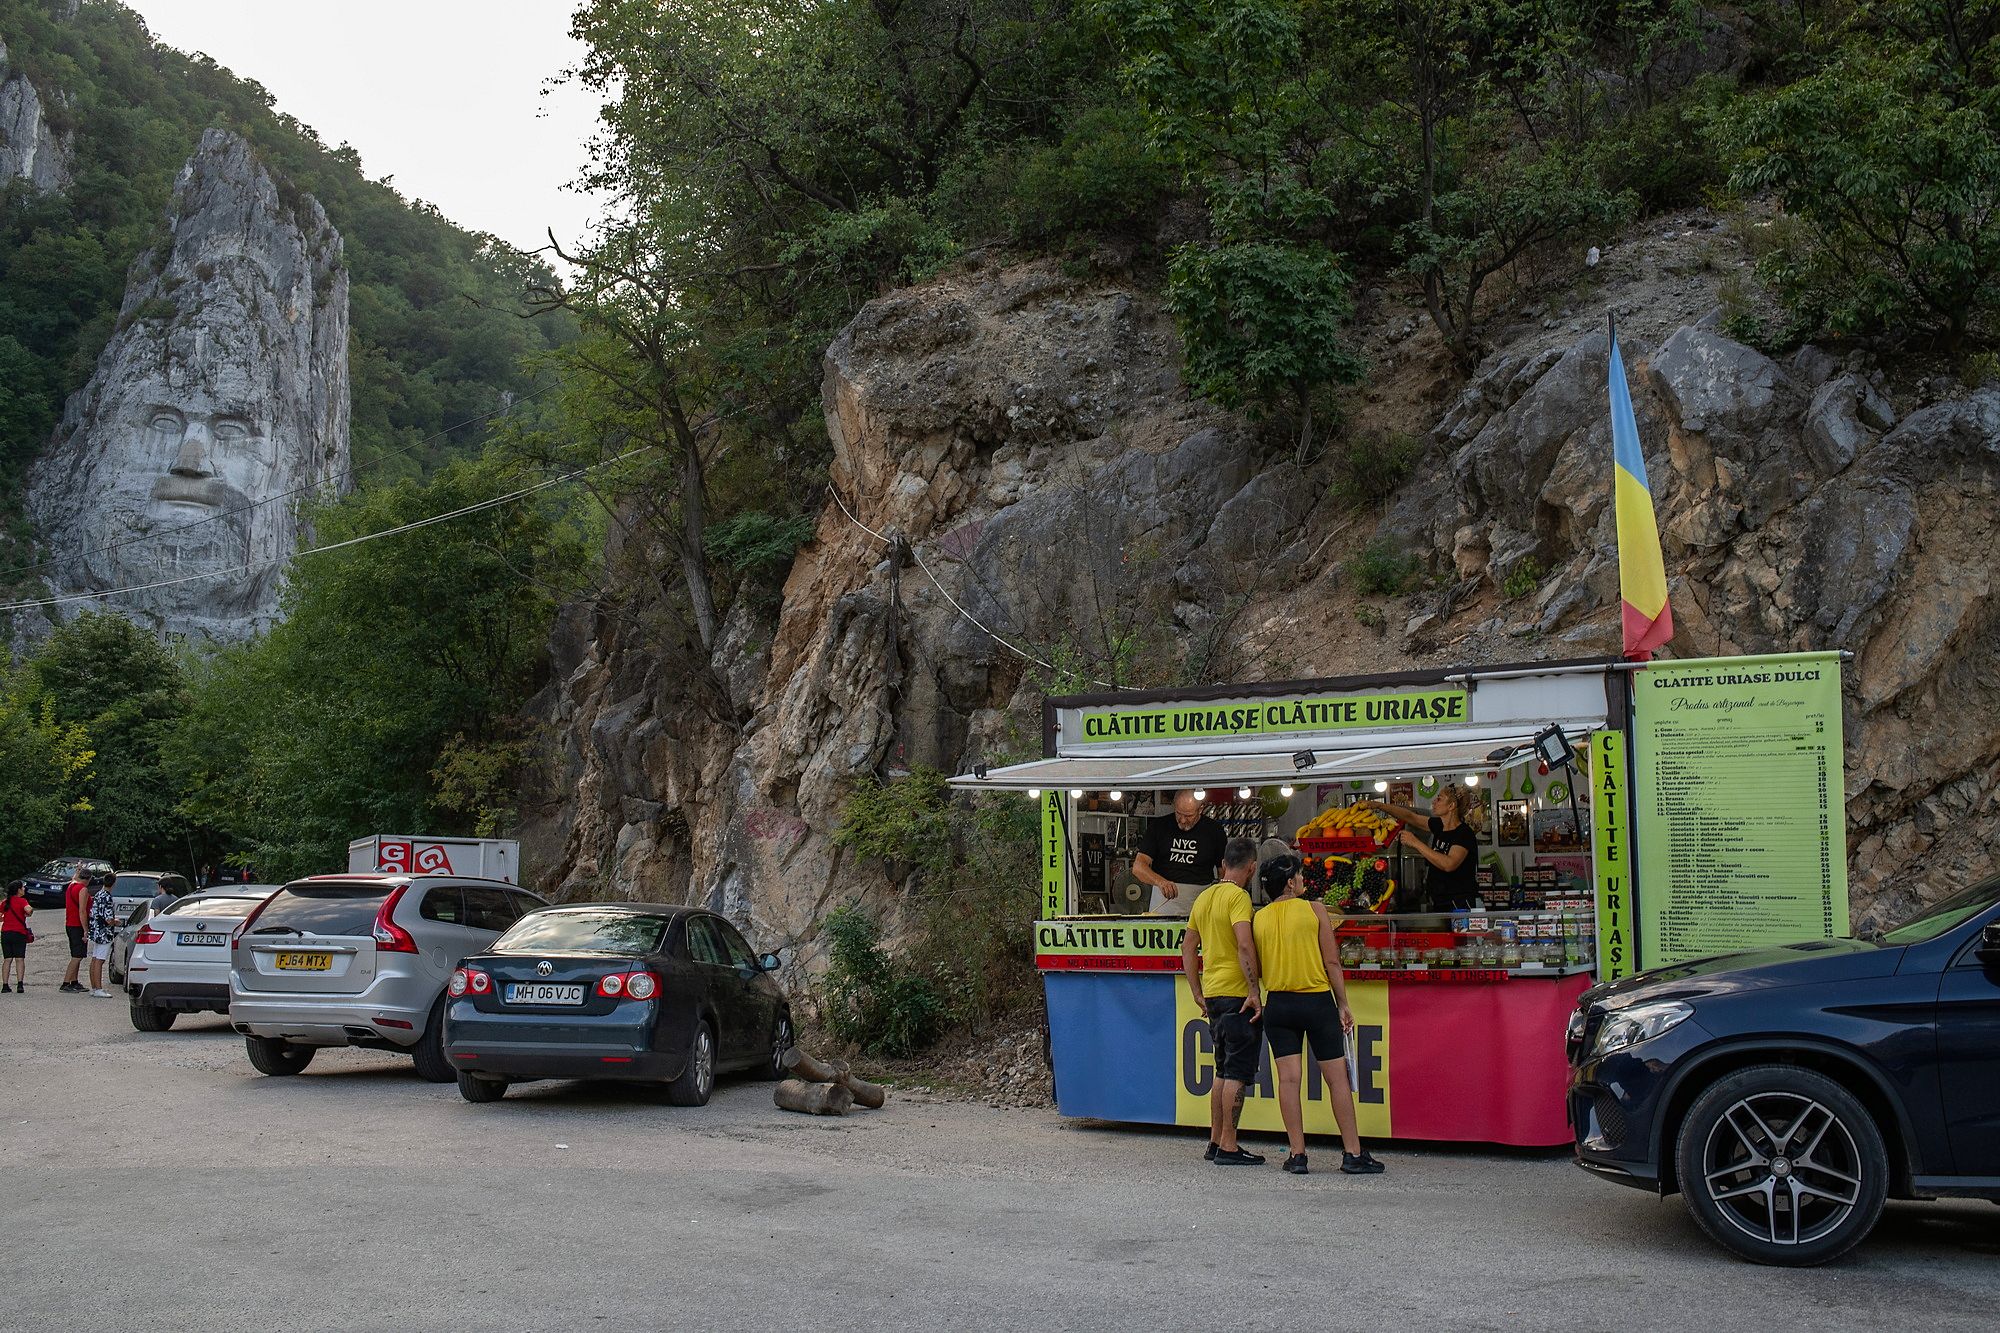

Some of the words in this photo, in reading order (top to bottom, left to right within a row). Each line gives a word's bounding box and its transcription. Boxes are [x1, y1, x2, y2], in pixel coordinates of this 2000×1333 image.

[1653, 677, 1713, 688] CLATITE
[1717, 673, 1771, 685] URIASE
[1775, 670, 1820, 682] DULCI
[1671, 697, 1709, 711] Produs
[1713, 697, 1755, 712] artizanal
[1172, 839, 1197, 849] NYC
[184, 935, 194, 943] GJ
[207, 935, 222, 943] DNL
[278, 954, 304, 966] FJ64
[306, 956, 327, 967] MTX
[515, 986, 534, 998] MH
[538, 987, 553, 999] 06
[556, 987, 580, 999] VJC
